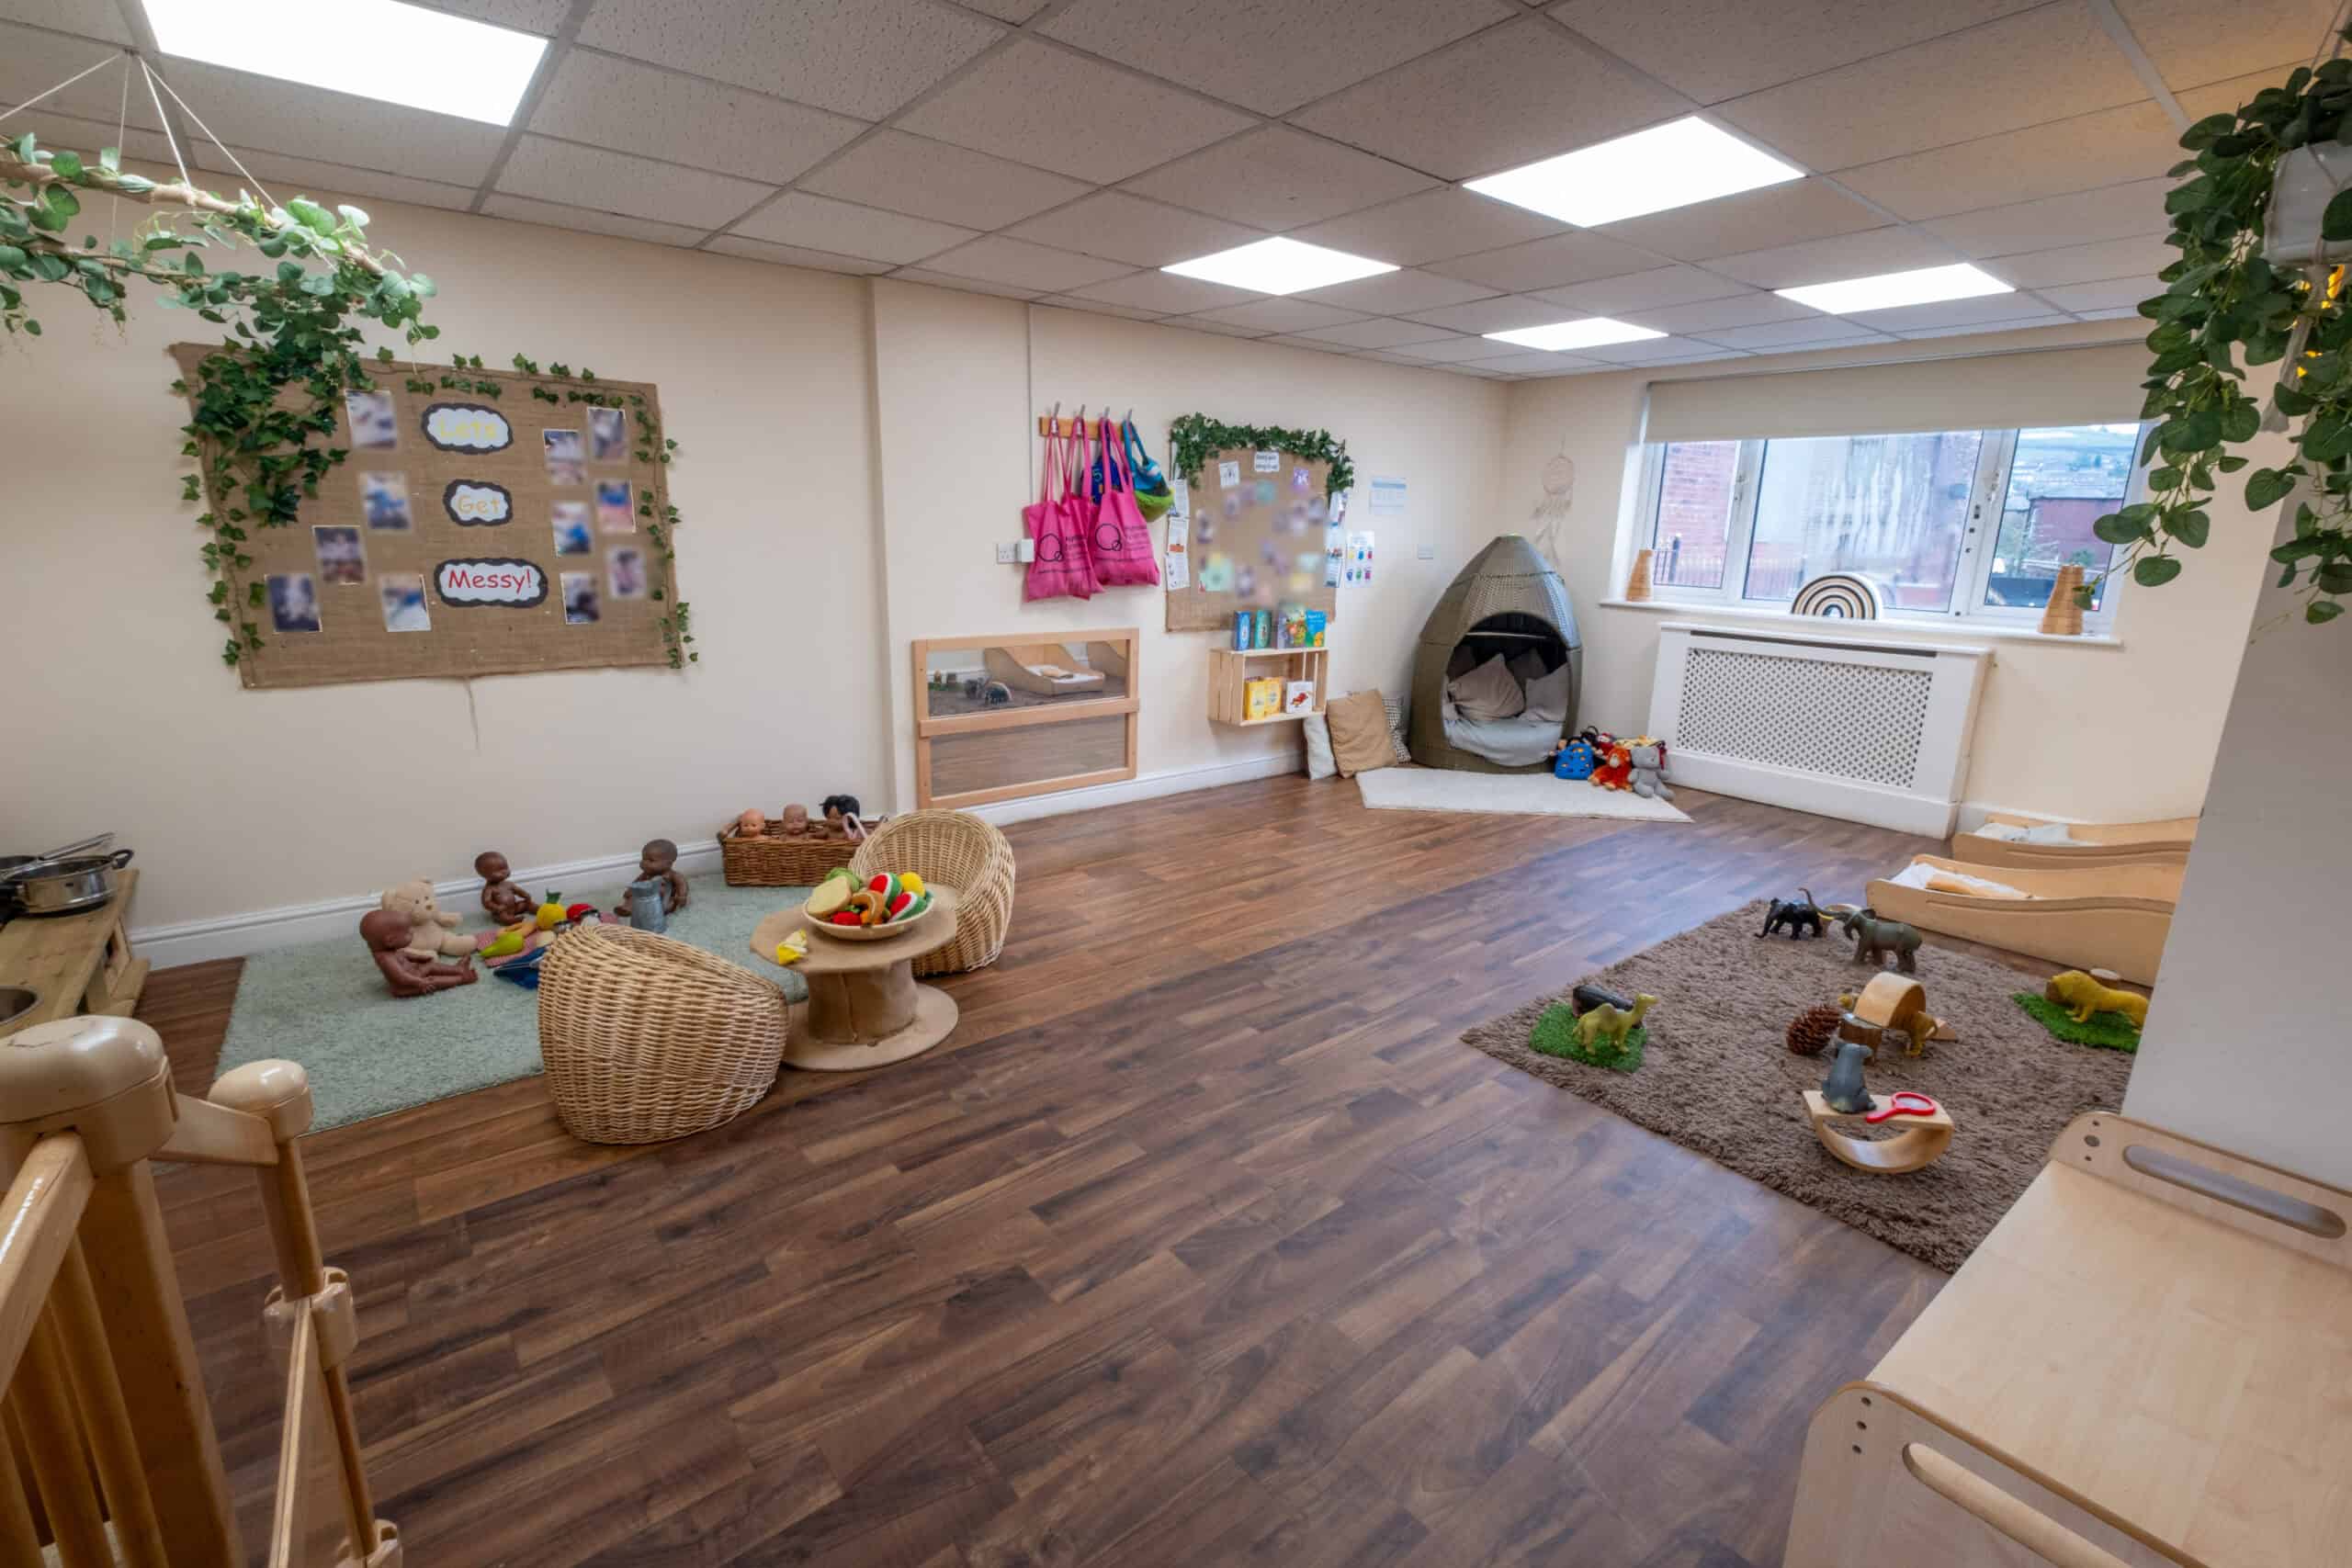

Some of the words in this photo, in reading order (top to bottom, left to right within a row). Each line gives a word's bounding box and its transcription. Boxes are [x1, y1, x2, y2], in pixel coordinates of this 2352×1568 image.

[439, 418, 497, 438] Lets
[457, 495, 500, 514] Get
[447, 569, 531, 594] Messy!
